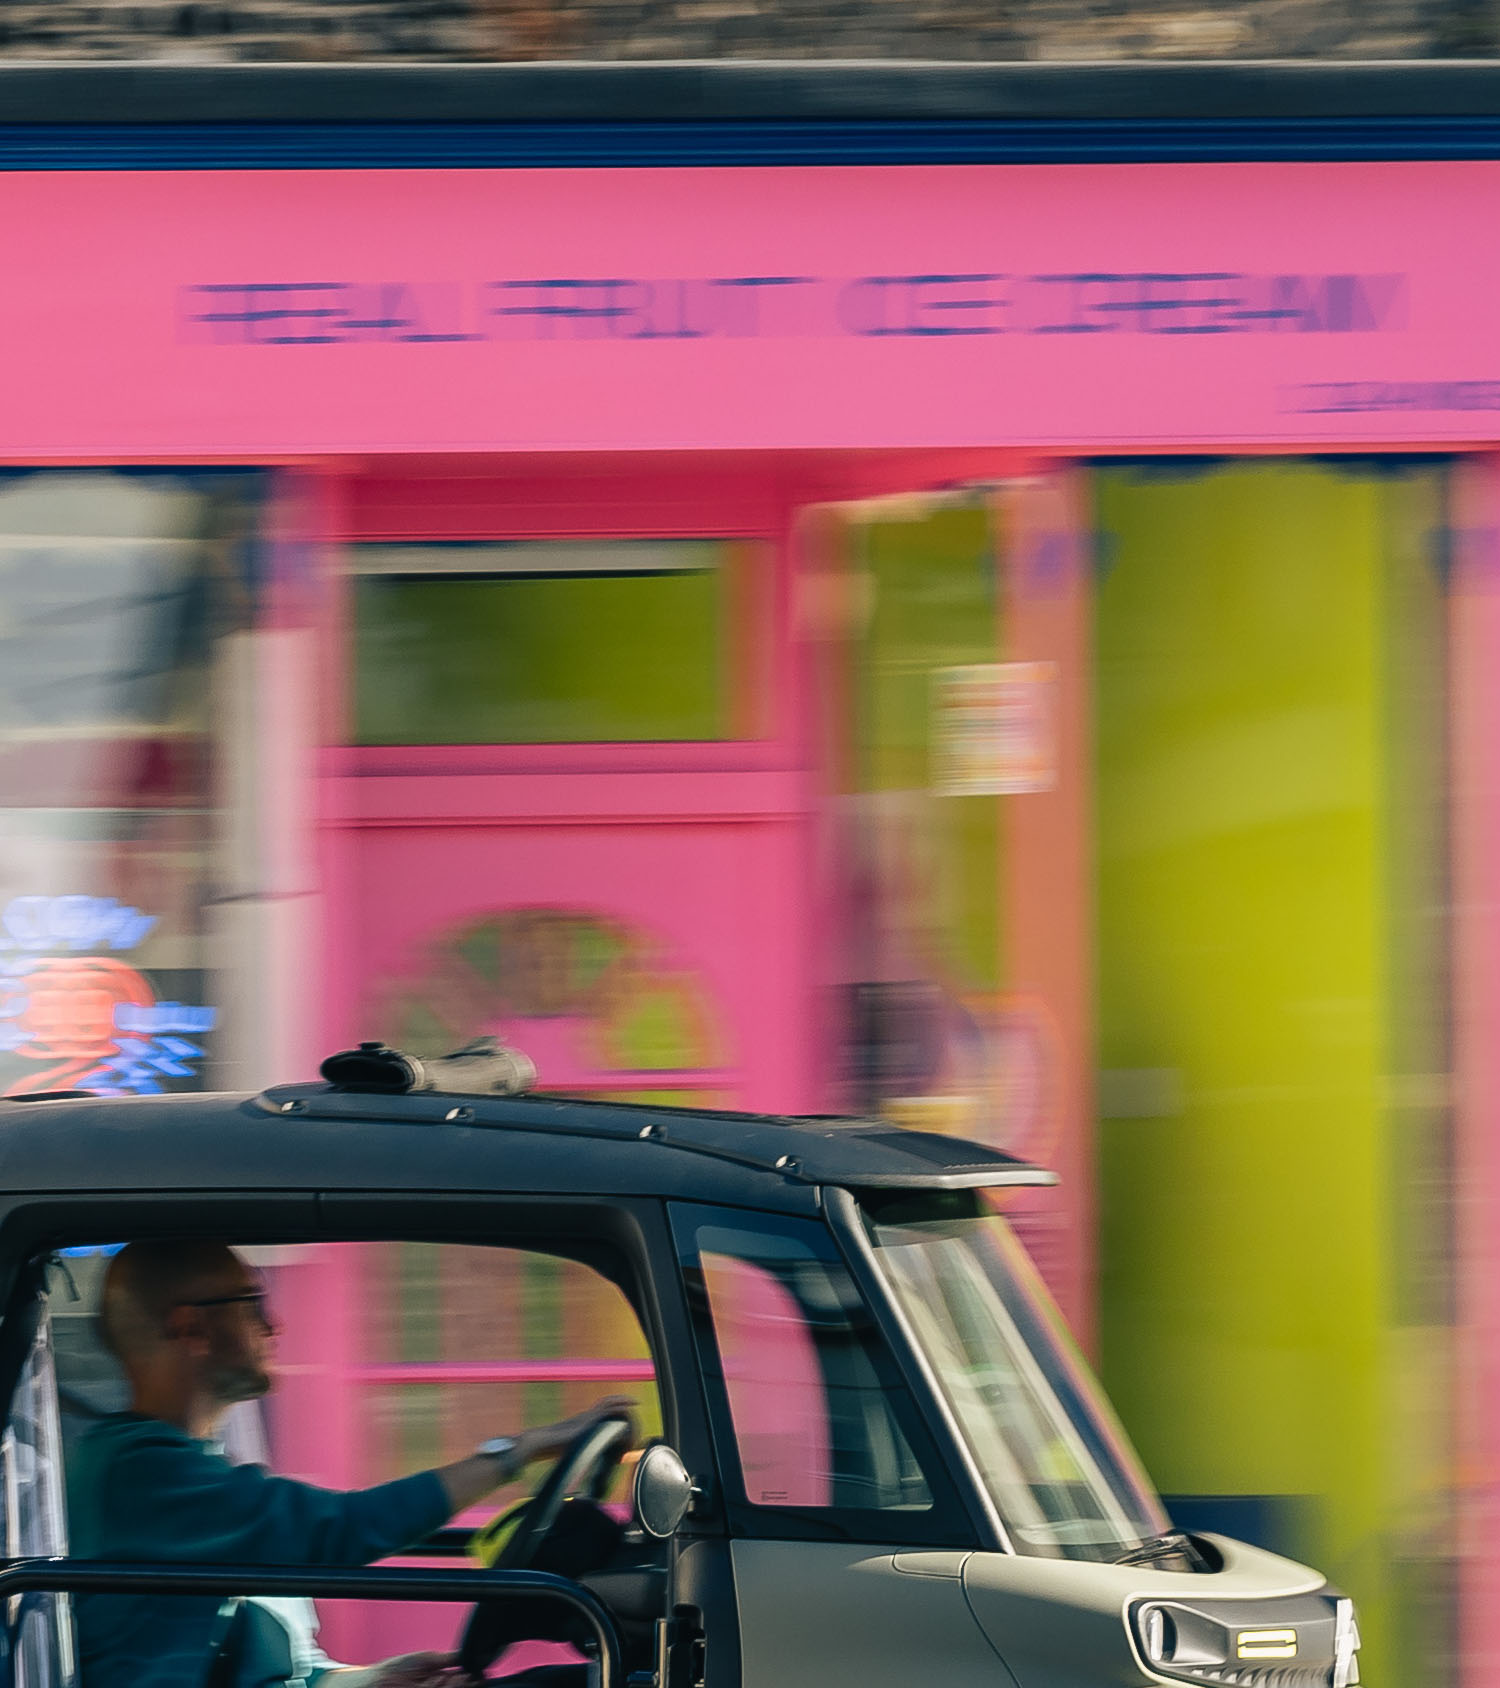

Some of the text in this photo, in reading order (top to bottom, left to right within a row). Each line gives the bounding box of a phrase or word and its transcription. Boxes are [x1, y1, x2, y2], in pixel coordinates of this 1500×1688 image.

[182, 282, 484, 346] REAL
[486, 277, 812, 341] FRUIT
[1018, 270, 1408, 335] CREAM
